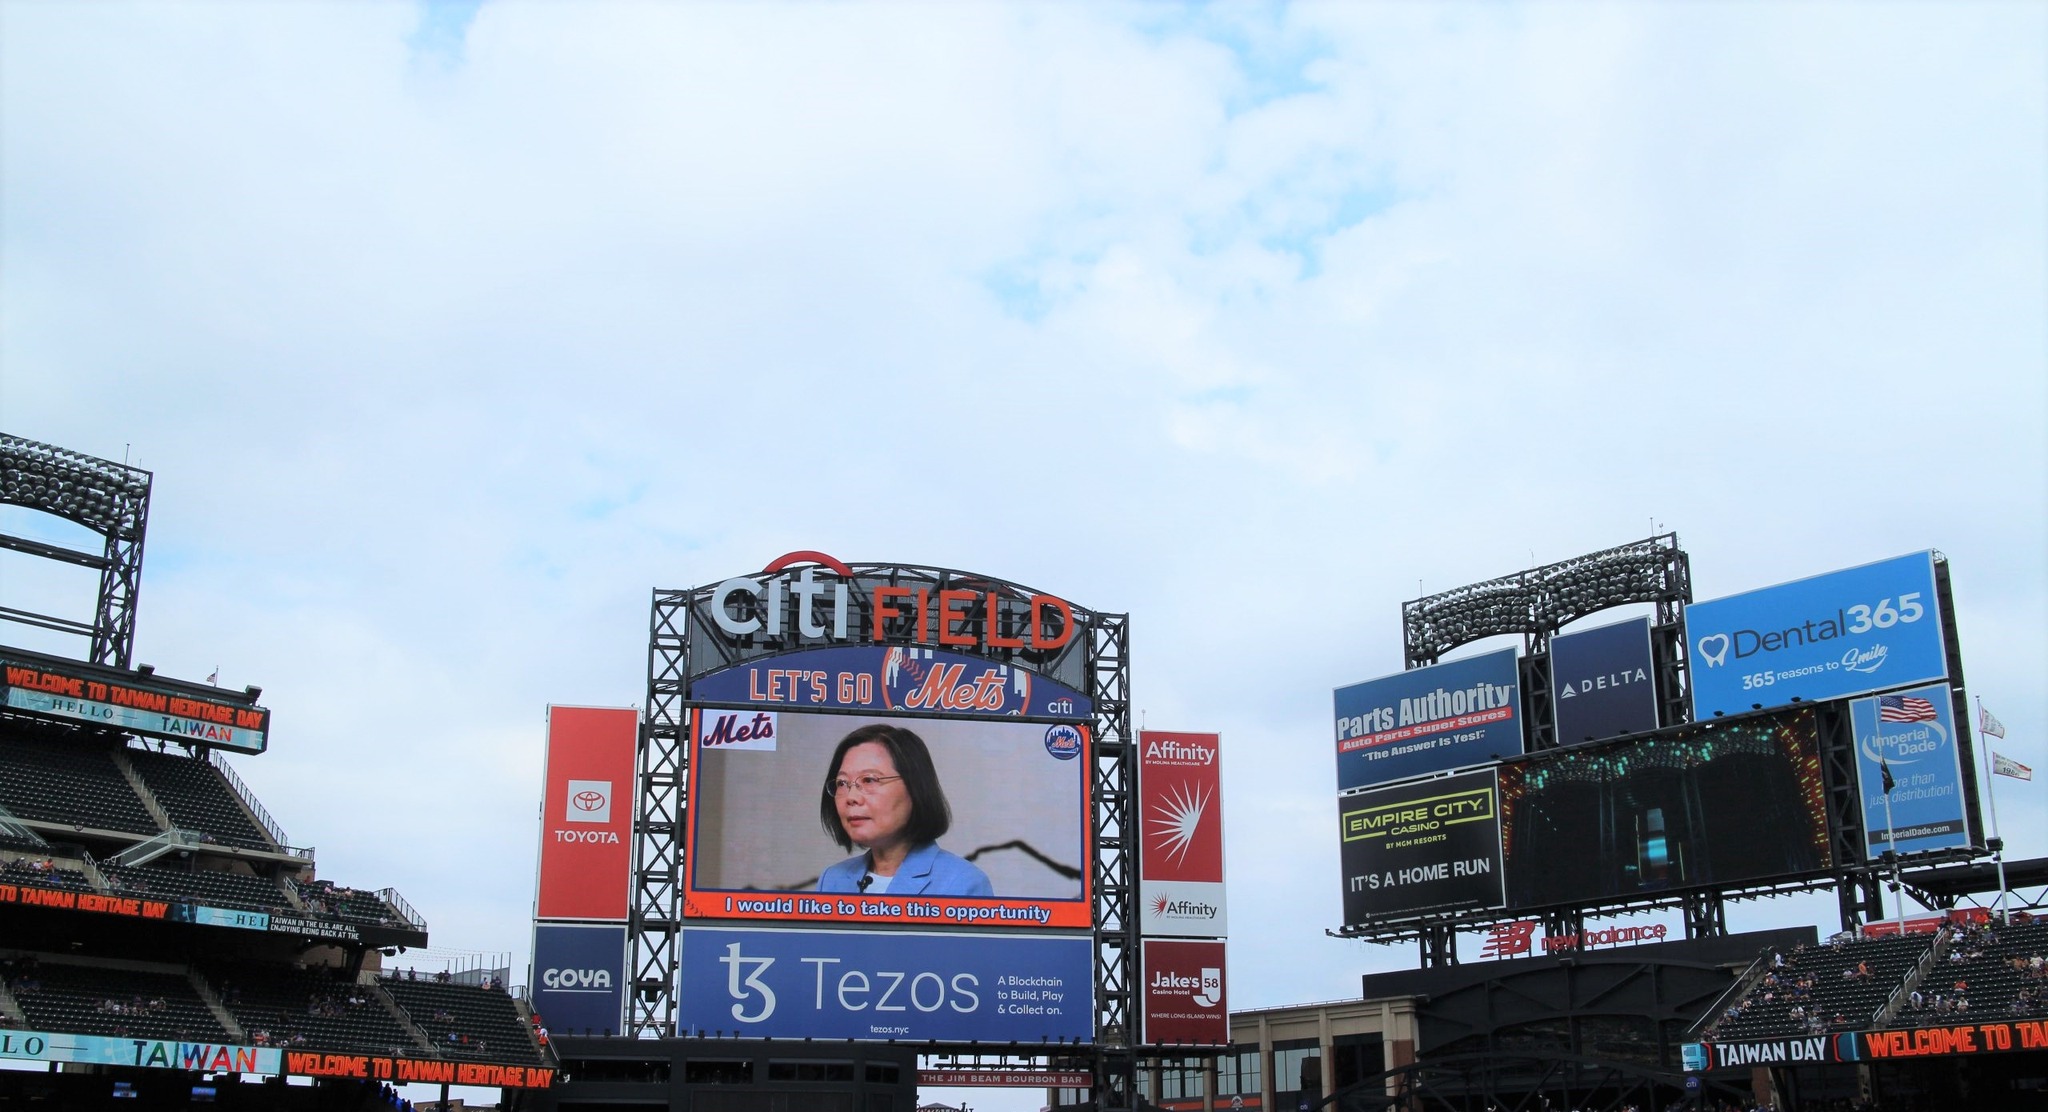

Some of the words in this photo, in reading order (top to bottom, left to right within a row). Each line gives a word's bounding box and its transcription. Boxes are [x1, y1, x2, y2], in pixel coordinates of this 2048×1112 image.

[711, 567, 848, 639] citi
[872, 586, 1075, 650] FIELD
[1732, 591, 1924, 660] Dental365
[1742, 670, 1776, 691] 365
[1776, 662, 1824, 681] reasons
[1826, 660, 1840, 671] to
[1841, 643, 1889, 672] Smile
[749, 668, 827, 703] LET'S
[836, 672, 873, 705] GO
[905, 663, 1007, 711] Mets
[1581, 667, 1647, 694] DELTA
[6, 666, 83, 698] WELCOME
[88, 682, 107, 701] TO
[111, 686, 167, 712] TAIWAN
[169, 696, 234, 725] HERITAGE
[236, 709, 264, 730] DAY
[52, 698, 114, 720] HELLO
[1048, 701, 1073, 715] citi
[1337, 705, 1395, 741] Parts
[1399, 682, 1510, 728] Authority
[161, 716, 232, 742] TAIWAN
[703, 713, 774, 747] Mets
[1342, 737, 1372, 750] Auto
[1375, 730, 1411, 743] Parts
[1413, 721, 1455, 737] Super
[1457, 709, 1507, 727] Stores
[1872, 727, 1930, 748] Imperial
[1145, 740, 1215, 766] Affinity
[1391, 740, 1436, 756] Answer
[1439, 736, 1451, 747] Is
[1898, 739, 1936, 756] Dade
[1911, 773, 1935, 786] than
[1891, 782, 1954, 803] distribution!
[1350, 808, 1428, 832] EMPIRE
[1434, 798, 1483, 817] CITY
[555, 830, 619, 844] TOYOTA
[1391, 820, 1440, 836] CASINO
[1396, 840, 1413, 848] MGM
[1414, 834, 1447, 846] RESORTS
[1351, 873, 1380, 892] IT'S
[1384, 872, 1395, 888] A
[1399, 863, 1450, 885] HOME
[1453, 857, 1491, 877] RUN
[0, 885, 17, 902] TO
[21, 887, 75, 909] TAIWAN
[78, 893, 141, 916] HERITAGE
[142, 901, 169, 919] DAY
[725, 896, 732, 912] I
[737, 898, 793, 915] would
[798, 899, 834, 916] like
[837, 901, 856, 916] to
[861, 901, 901, 918] take
[906, 902, 941, 918] this
[945, 904, 1051, 924] opportunity
[1167, 901, 1217, 919] Affinity
[236, 914, 268, 927] HEL
[271, 916, 297, 926] TAIWAN
[332, 923, 344, 931] ARE
[270, 924, 300, 934] ENJOYING
[302, 928, 319, 936] BEING
[321, 929, 337, 937] BACK
[338, 931, 346, 939] AT
[347, 932, 359, 940] THE
[1541, 933, 1580, 951] new
[1583, 924, 1667, 947] balance
[542, 968, 611, 990] GOYA
[997, 976, 1006, 985] A
[1008, 976, 1063, 986] Blockchain
[1151, 971, 1200, 988] Jake's
[1204, 978, 1219, 988] 58
[997, 990, 1008, 1000] to
[1011, 990, 1039, 1001] Build,
[1042, 991, 1064, 1003] Play
[997, 1004, 1006, 1014] &
[1008, 1004, 1044, 1015] Collect
[1046, 1007, 1063, 1015] on.
[870, 1024, 909, 1036] tezos.nyc
[1866, 1026, 1977, 1058] WELCOME
[1980, 1023, 2012, 1050] TO
[133, 1040, 257, 1073] TAIWAN
[1716, 1041, 1789, 1067] TAIWAN
[1791, 1036, 1826, 1061] DAY
[288, 1052, 368, 1077] WELCOME
[372, 1057, 393, 1079] TO
[396, 1059, 454, 1083] TAIWAN
[457, 1063, 523, 1087] HERITAGE
[527, 1068, 553, 1089] DAY
[922, 1074, 943, 1082] THE
[947, 1074, 966, 1082] JIM
[971, 1075, 1000, 1083] BEAM
[1006, 1075, 1056, 1083] BOURBON
